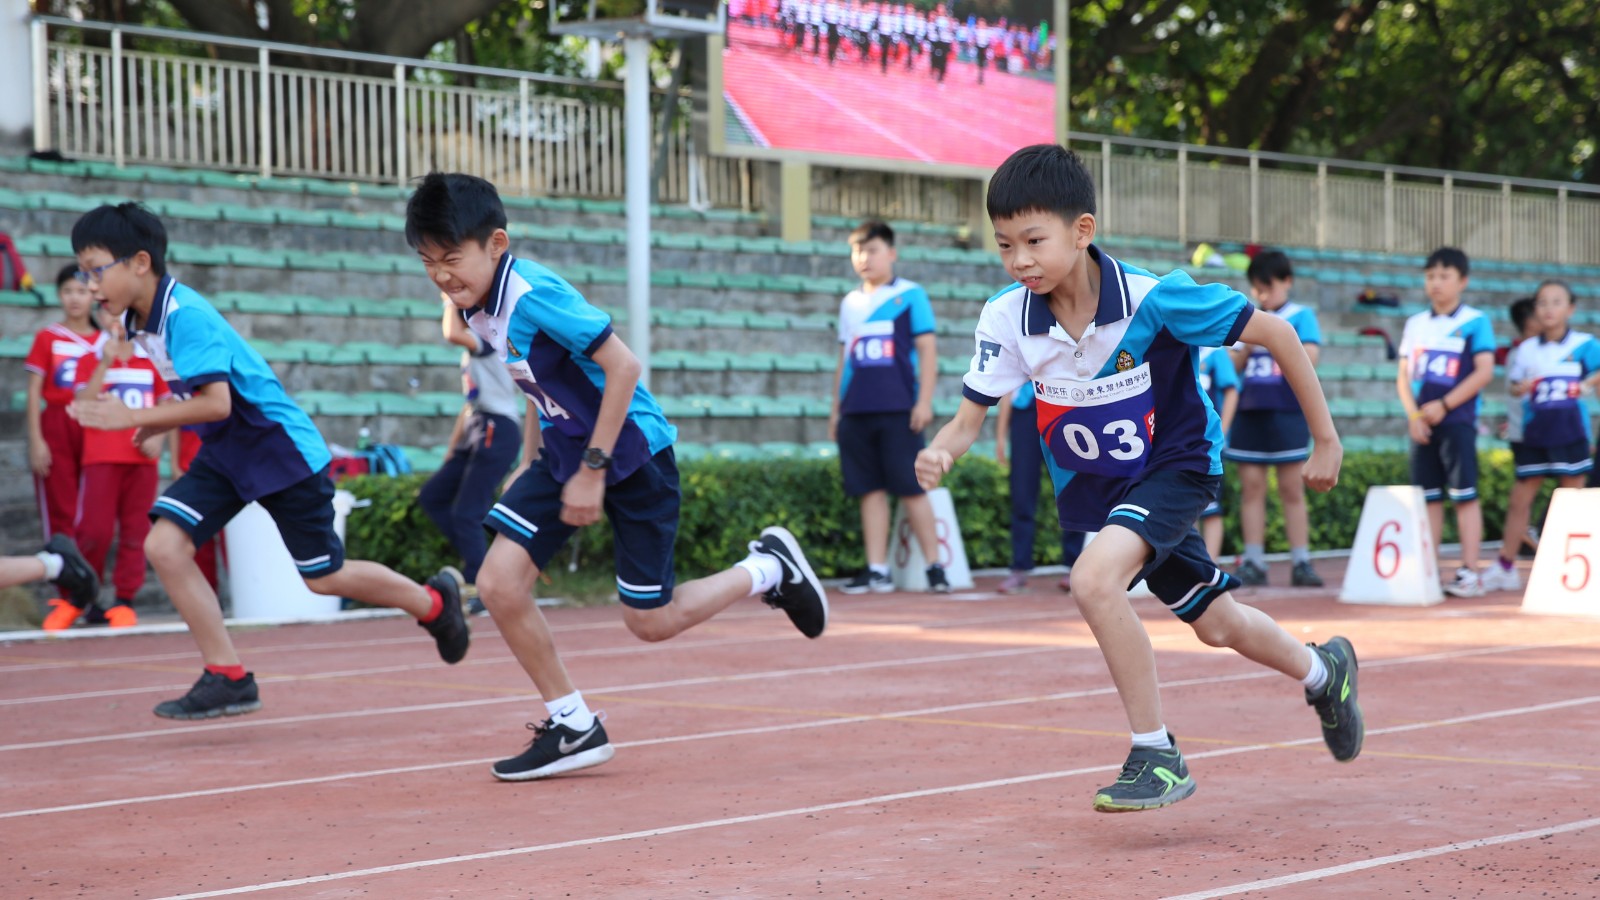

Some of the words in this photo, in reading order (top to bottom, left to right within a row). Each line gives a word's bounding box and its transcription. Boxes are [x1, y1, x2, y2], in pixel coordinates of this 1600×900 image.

[855, 338, 882, 361] 16
[978, 339, 1001, 372] F
[1417, 353, 1448, 376] 14
[1063, 419, 1145, 461] 03
[1373, 520, 1402, 579] 6
[1560, 532, 1592, 592] 5
